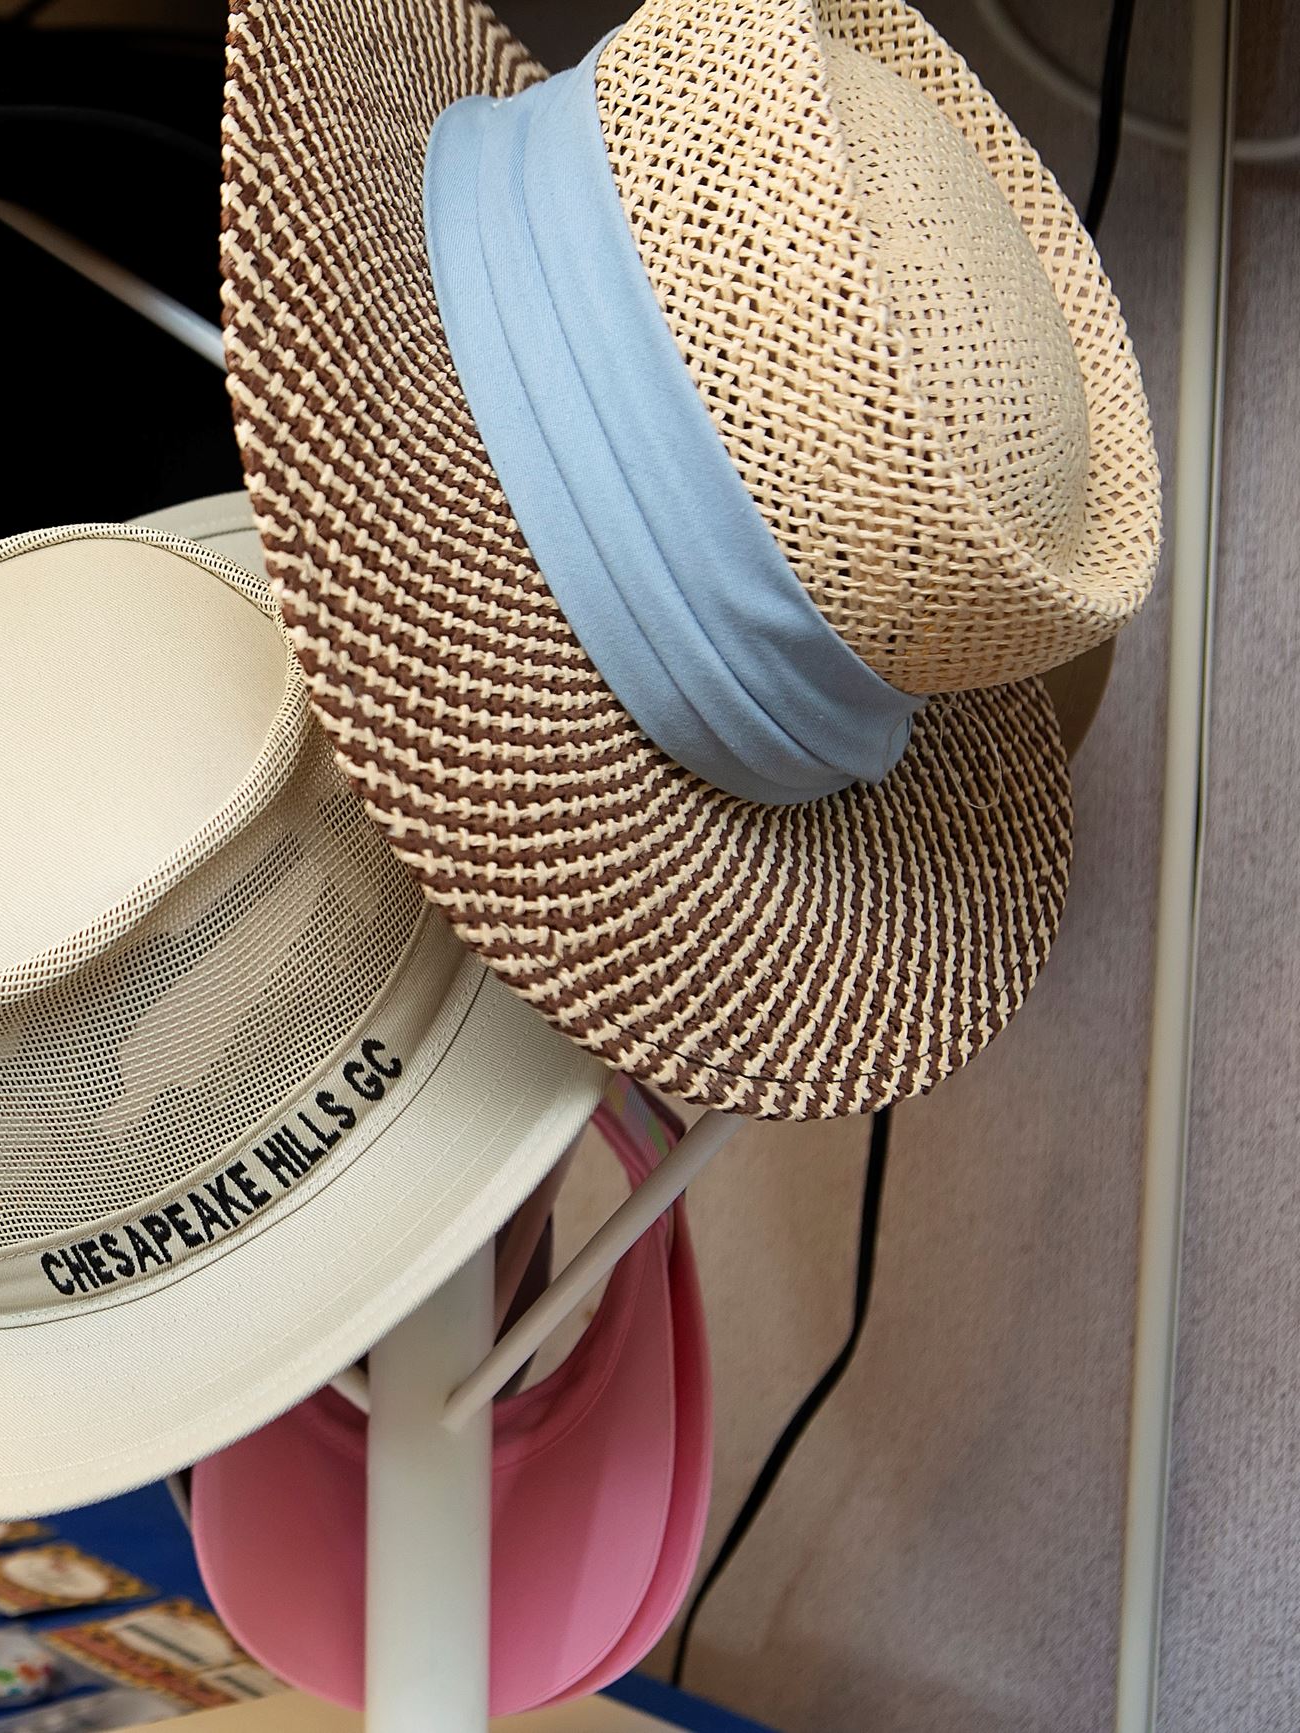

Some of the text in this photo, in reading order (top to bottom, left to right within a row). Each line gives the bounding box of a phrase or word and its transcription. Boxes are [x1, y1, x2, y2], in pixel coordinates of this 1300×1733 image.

[41, 1039, 402, 1296] CHESAPEAKE HILLS GC
